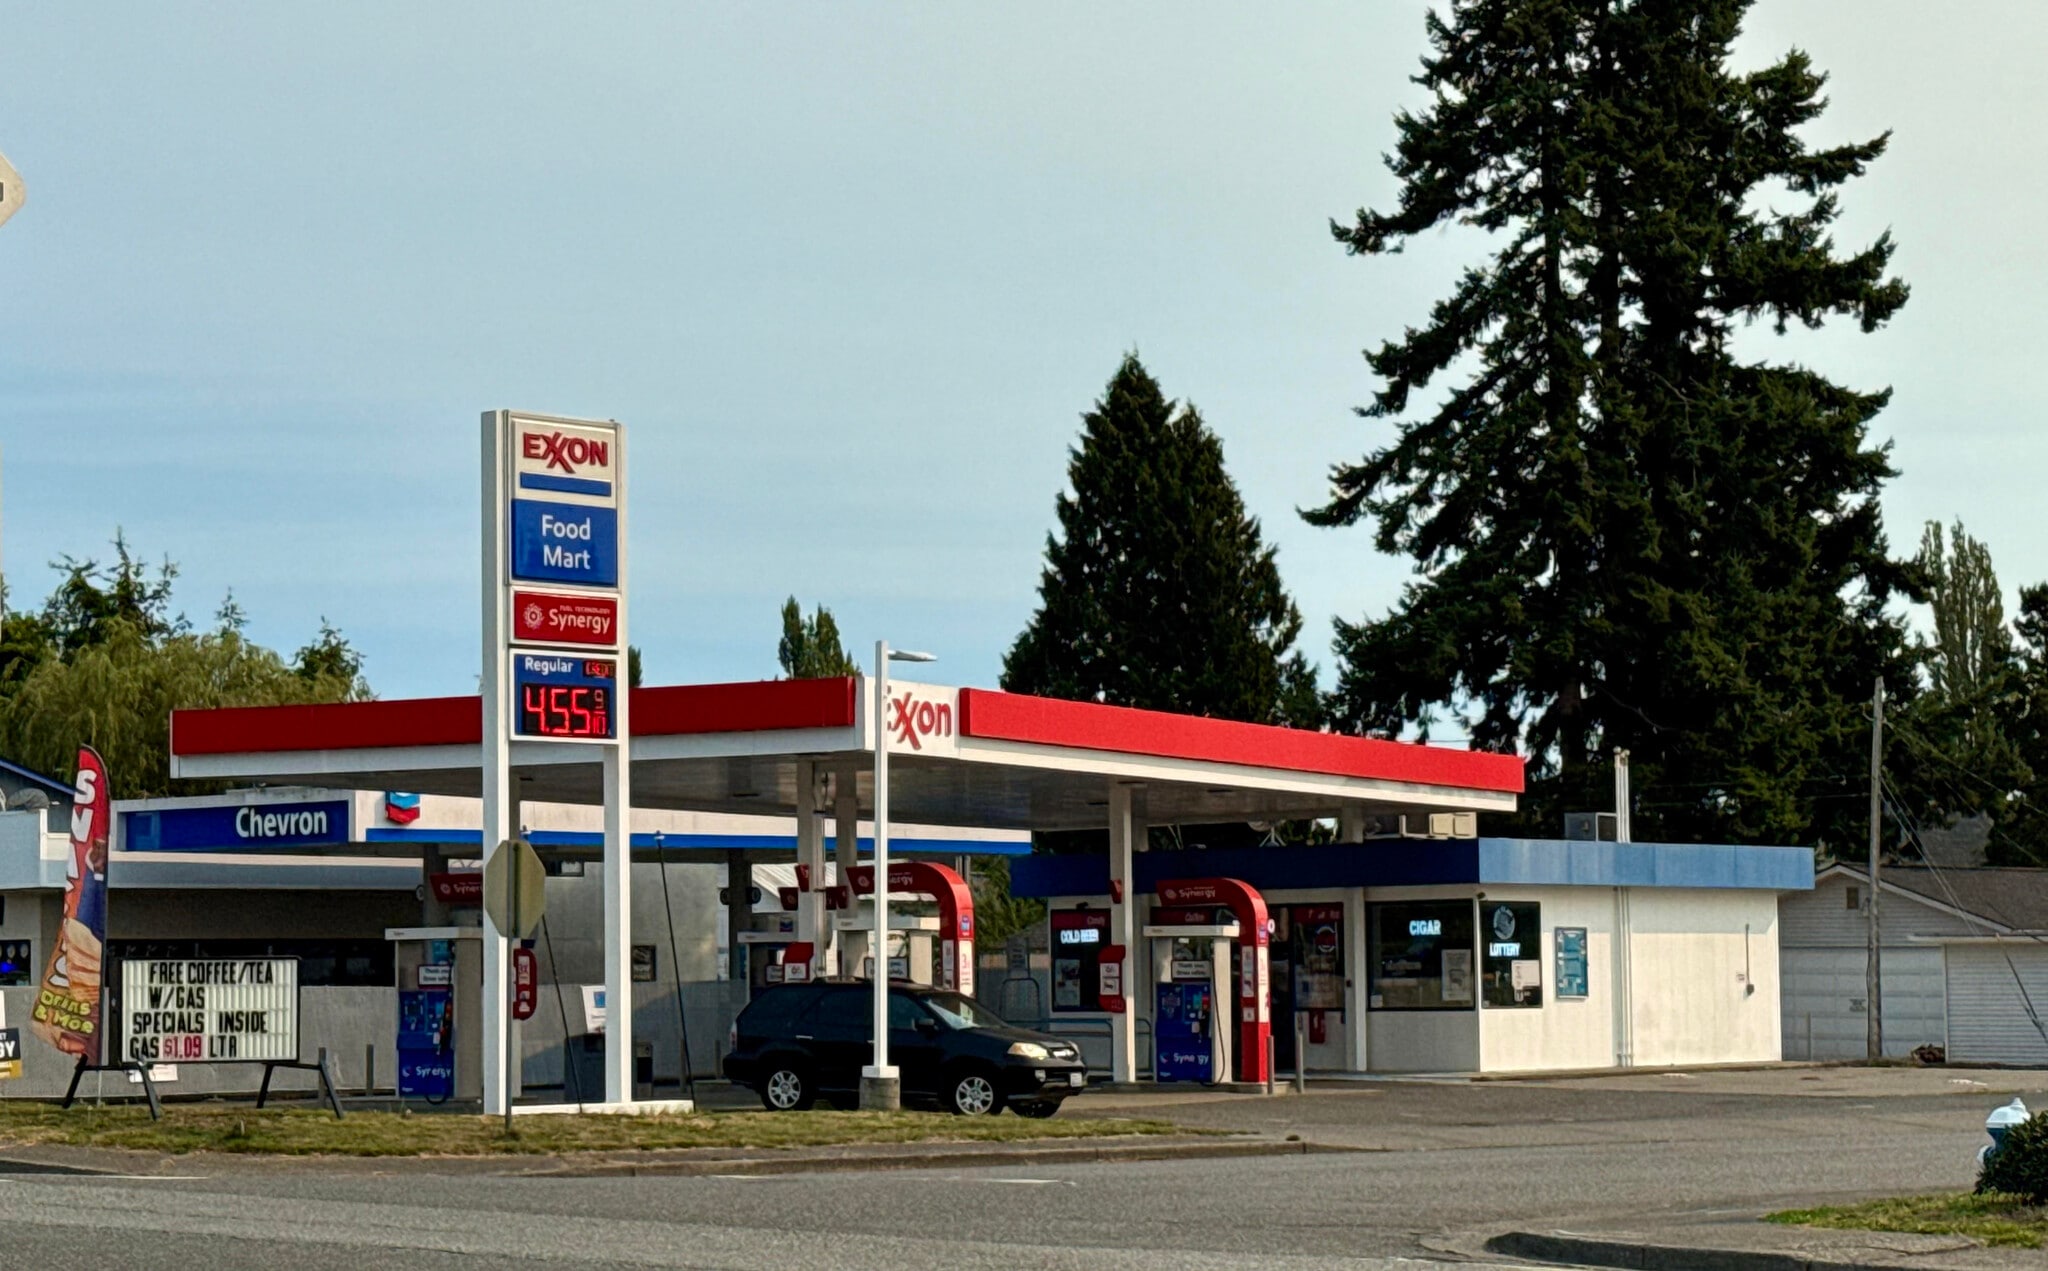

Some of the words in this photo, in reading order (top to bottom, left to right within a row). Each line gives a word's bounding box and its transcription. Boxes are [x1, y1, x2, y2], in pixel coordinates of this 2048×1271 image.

[523, 432, 608, 474] EXXON
[541, 513, 591, 540] Food
[543, 544, 591, 570] Mart
[548, 608, 611, 634] Synergy
[524, 656, 574, 676] Regular
[525, 685, 592, 734] 4.55
[235, 807, 327, 838] Chevron
[1178, 888, 1216, 899] Synergy
[1060, 929, 1080, 944] COLD
[1409, 919, 1442, 936] CIGAR
[1489, 942, 1521, 957] LOTTERY
[150, 961, 183, 985] FREE
[188, 961, 273, 985] COFFEE/TEA
[150, 986, 205, 1009] W/GAS
[133, 1011, 204, 1035] SPECIALS
[218, 1011, 267, 1034] INSIDE
[130, 1036, 159, 1059] GAS
[163, 1035, 202, 1059] $1.09
[1173, 1052, 1209, 1065] Synegy
